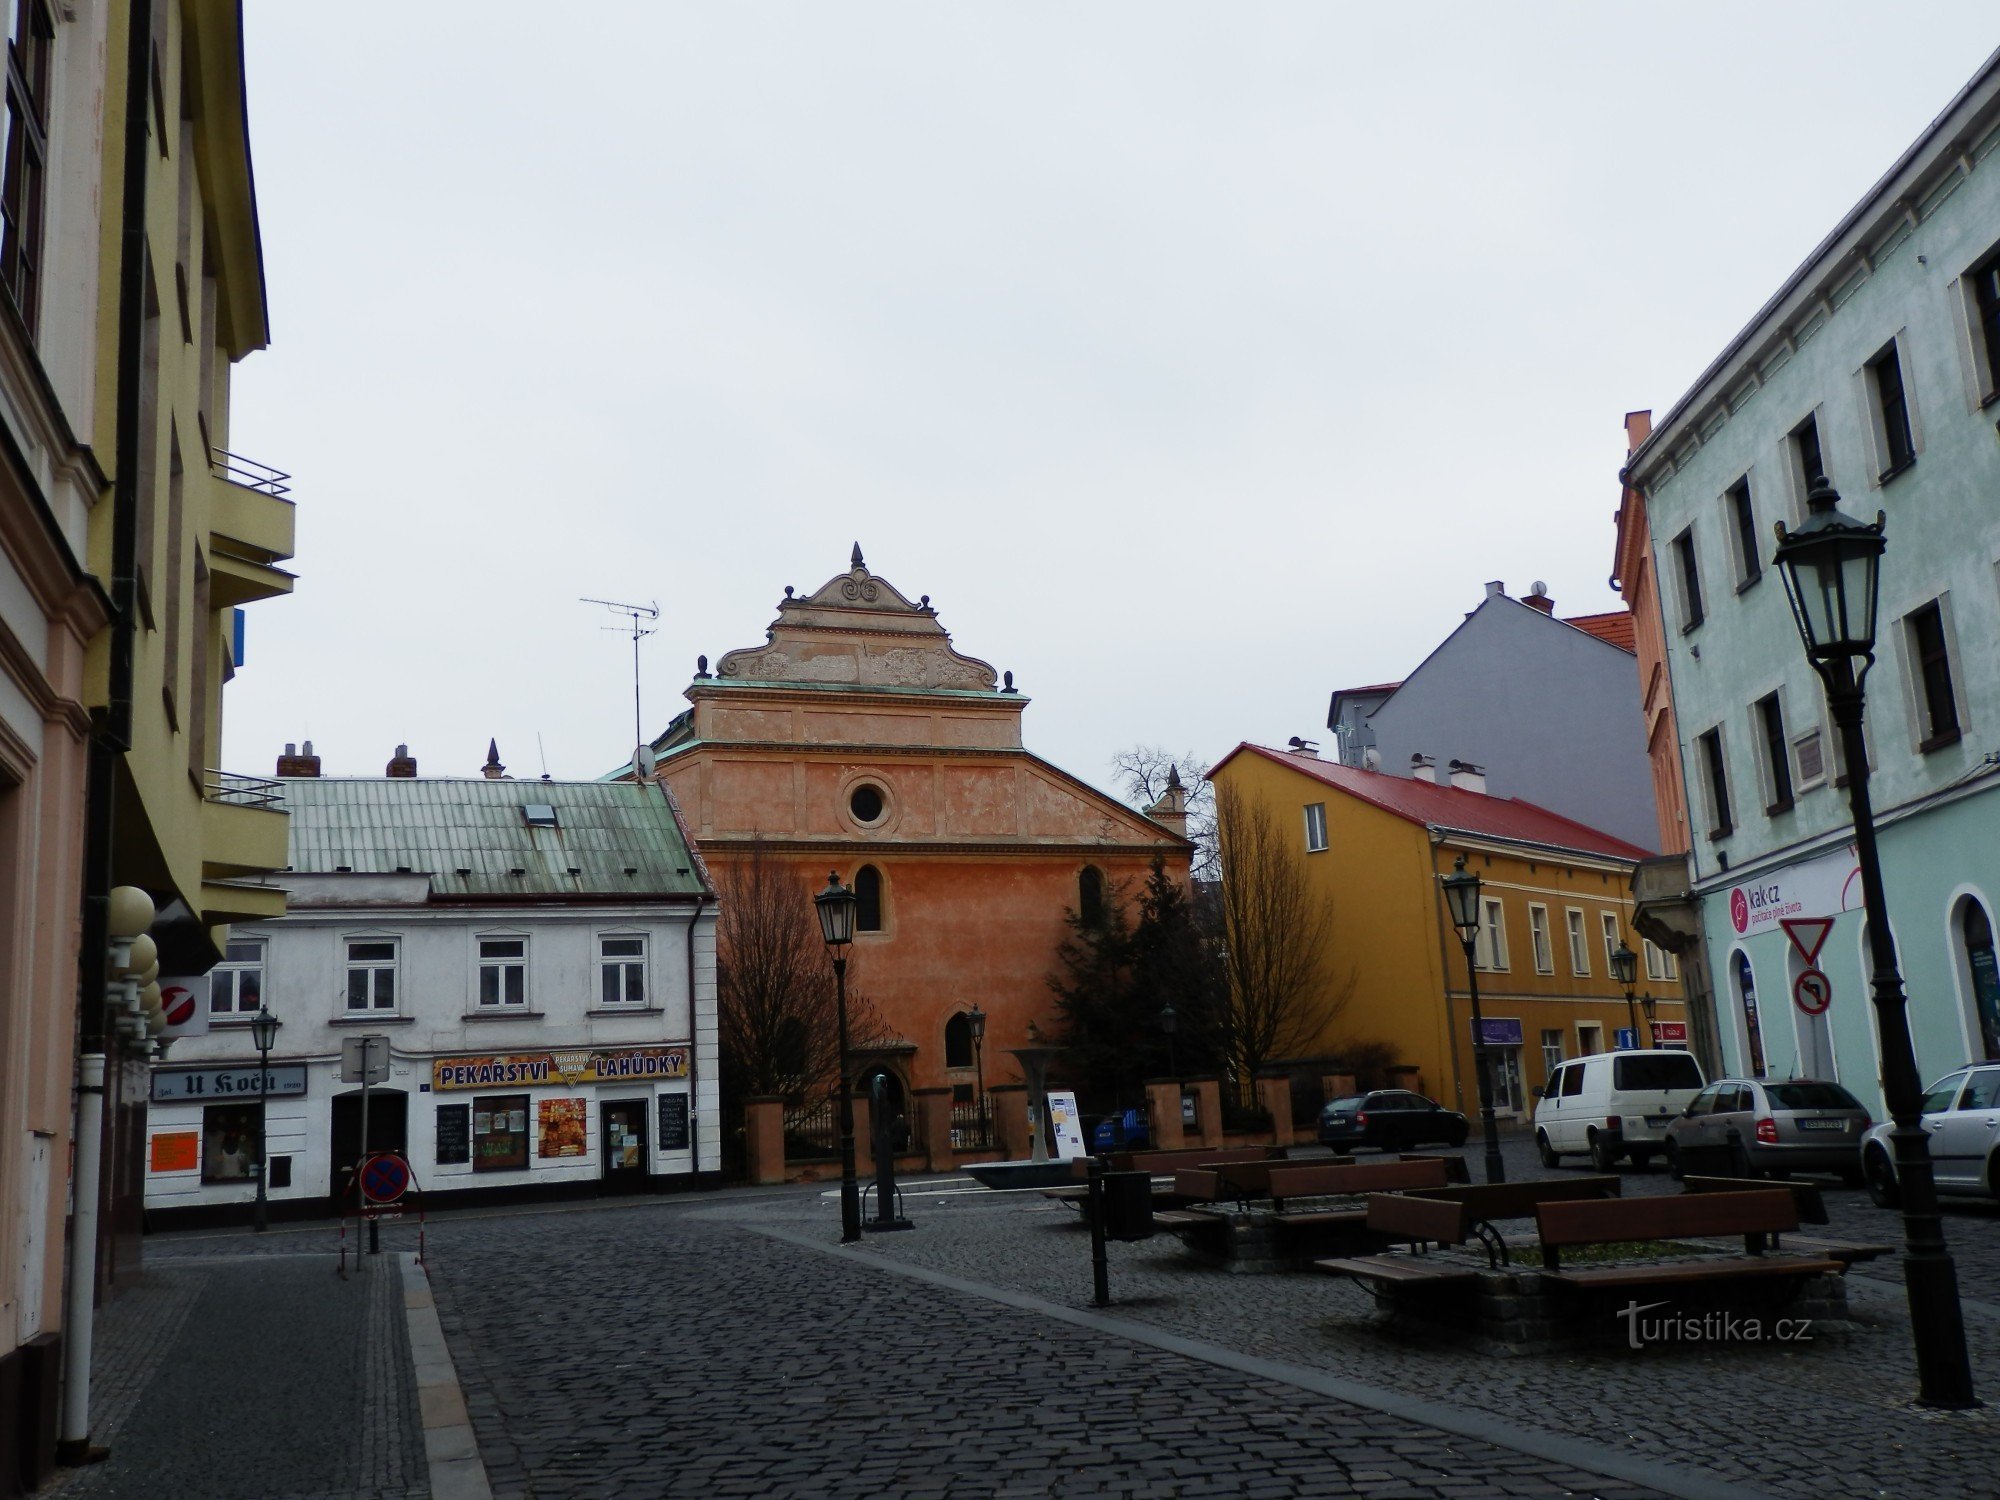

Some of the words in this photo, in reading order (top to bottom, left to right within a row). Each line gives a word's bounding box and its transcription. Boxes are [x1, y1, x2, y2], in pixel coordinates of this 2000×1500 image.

[440, 1058, 549, 1085] PEKAŘSTVÍ
[595, 1052, 682, 1077] LAHŮDKY
[185, 1075, 204, 1094] U
